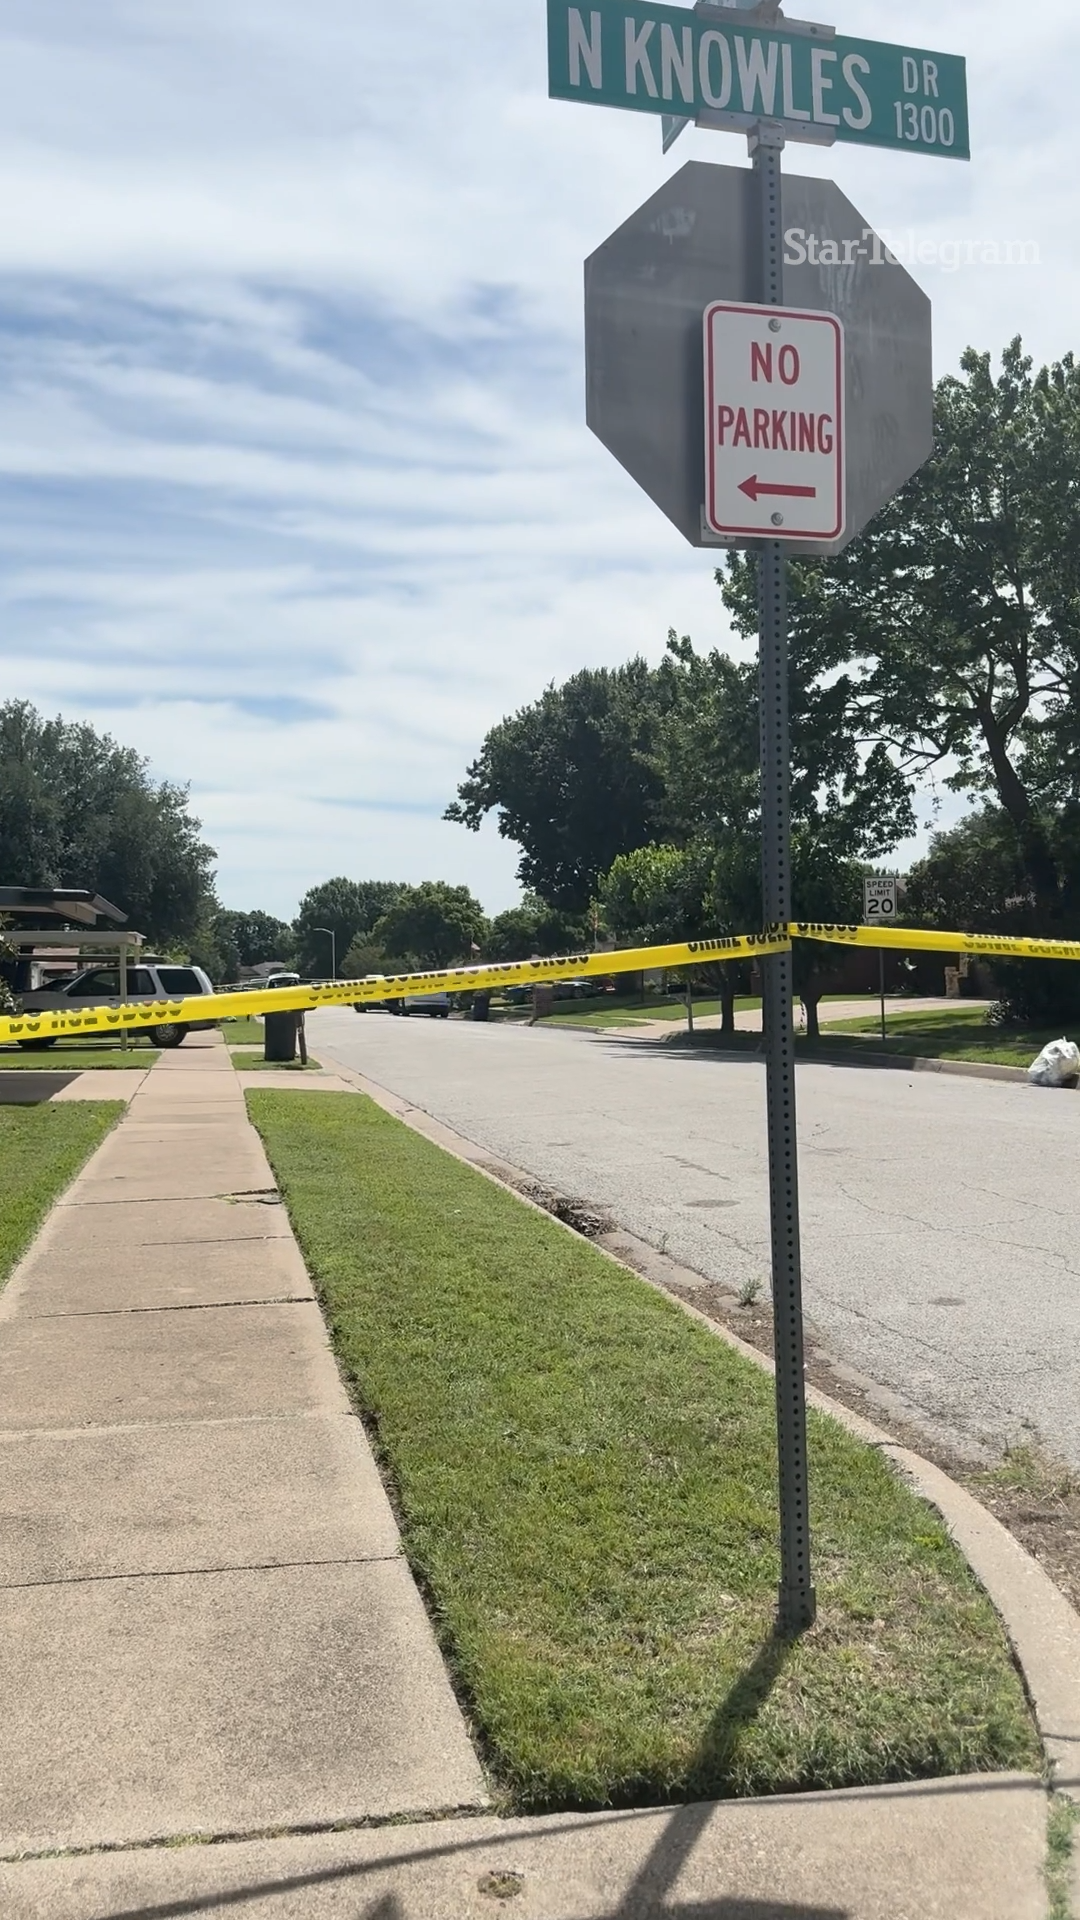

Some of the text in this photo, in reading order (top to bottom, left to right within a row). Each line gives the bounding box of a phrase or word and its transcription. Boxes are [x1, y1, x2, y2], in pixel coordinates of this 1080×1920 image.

[568, 6, 939, 130] N KNOWLES DR
[893, 100, 955, 147] 1300
[750, 341, 800, 386] NO
[717, 404, 833, 455] PARKING
[866, 880, 894, 888] SPEED
[867, 898, 893, 914] 20
[869, 889, 891, 897] LIMIT
